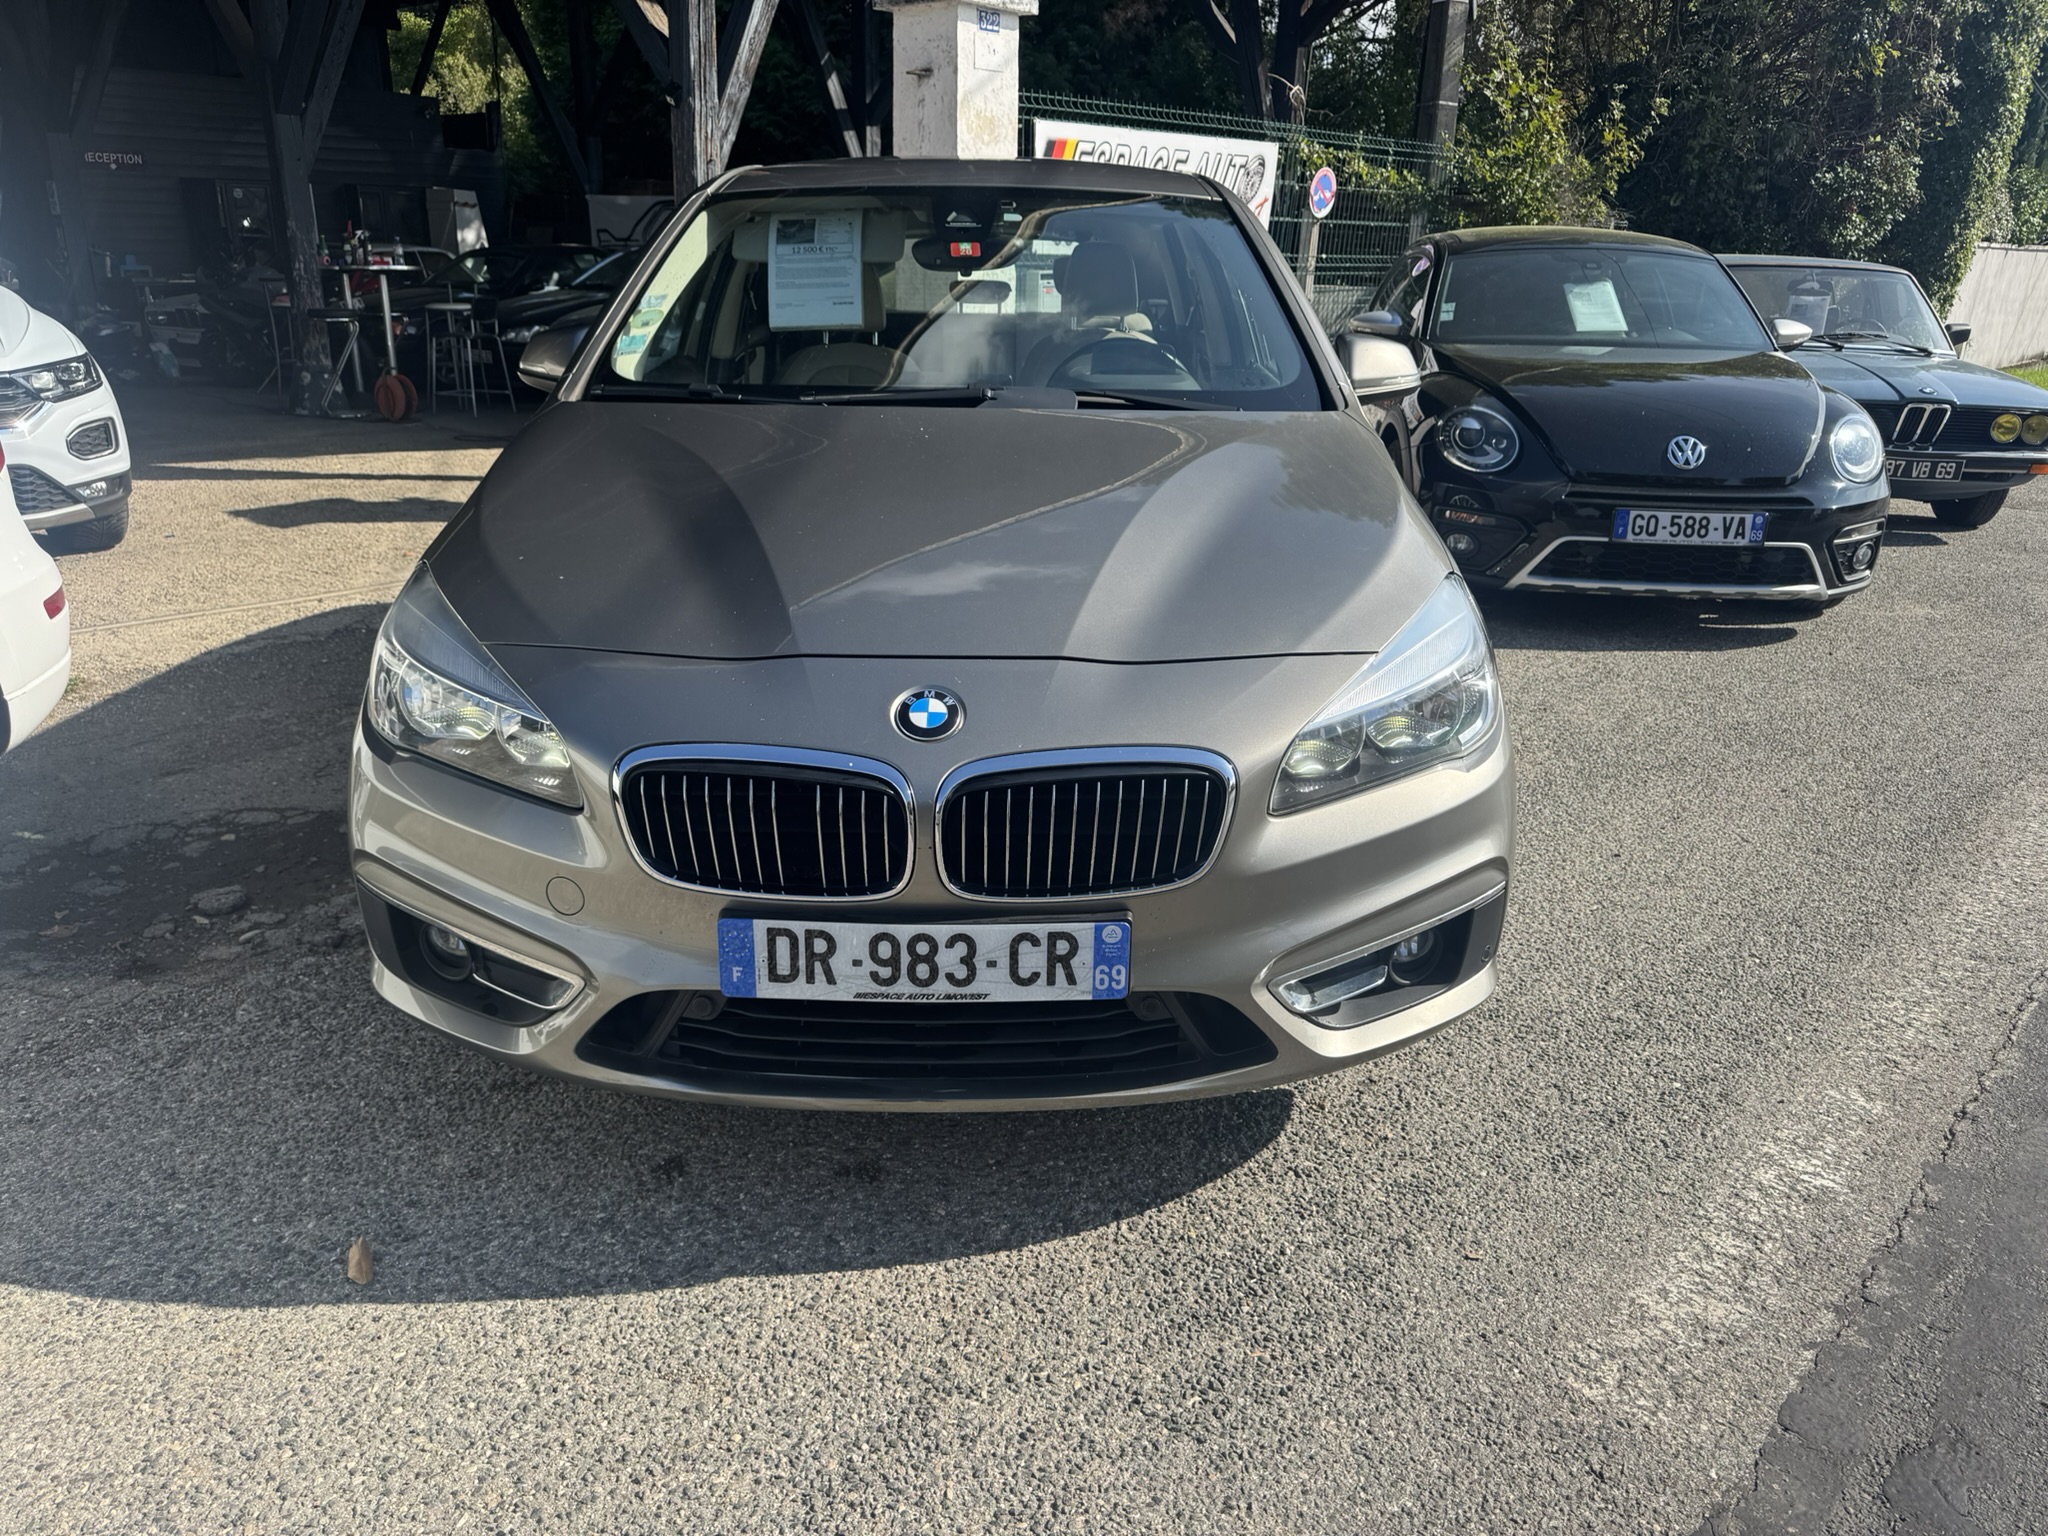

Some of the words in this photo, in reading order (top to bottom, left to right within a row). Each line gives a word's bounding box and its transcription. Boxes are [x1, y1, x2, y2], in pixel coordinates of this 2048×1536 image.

[980, 11, 1000, 31] 322
[803, 245, 818, 253] 500
[1911, 461, 1931, 478] VB
[1935, 462, 1957, 479] 69
[1751, 530, 1763, 541] 69
[766, 927, 1080, 988] DR-983-CR
[732, 966, 743, 982] F
[1095, 965, 1126, 990] 69
